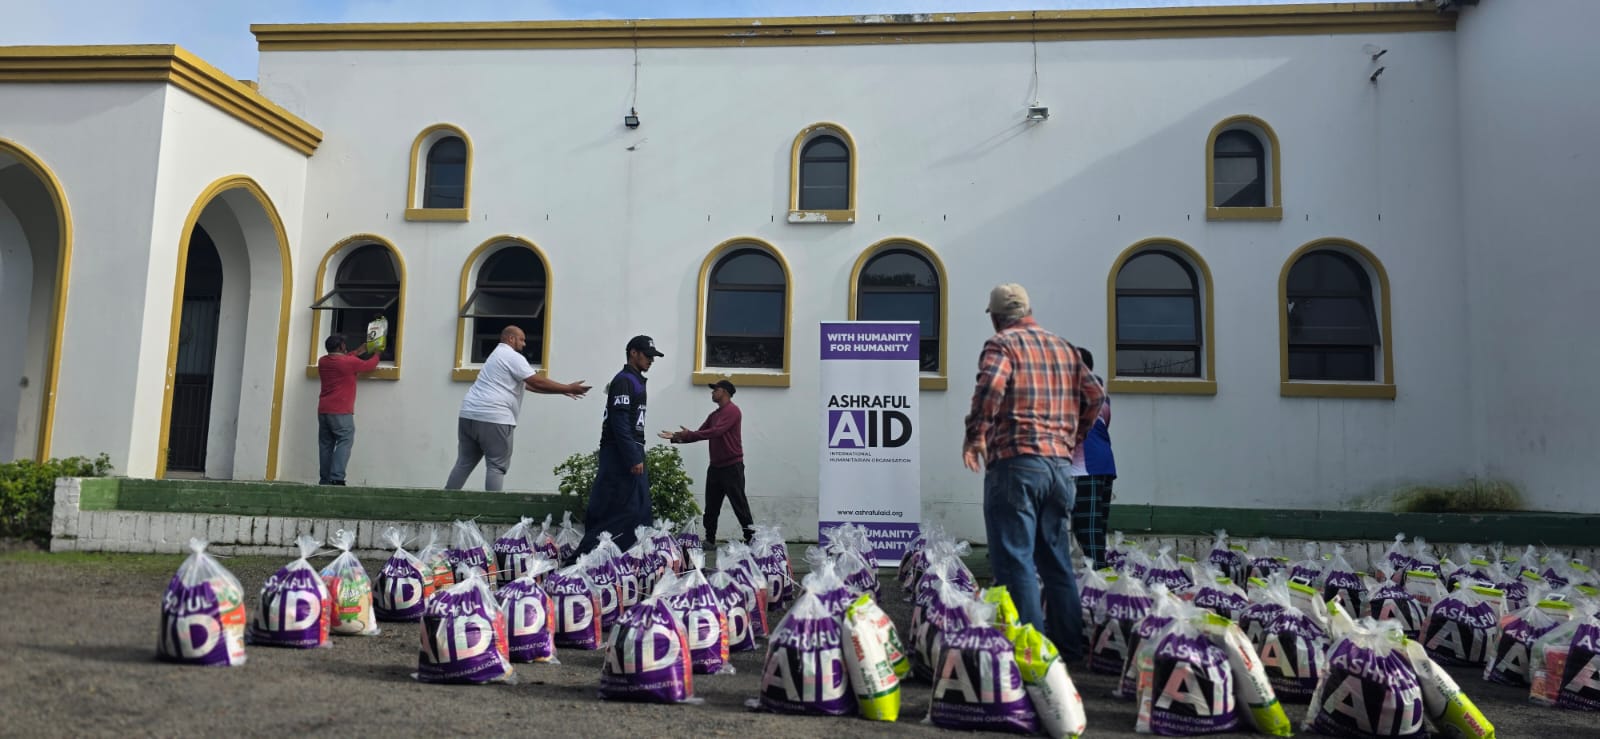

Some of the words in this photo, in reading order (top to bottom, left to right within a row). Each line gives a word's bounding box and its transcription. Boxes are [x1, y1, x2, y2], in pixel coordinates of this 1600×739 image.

[827, 333, 855, 342] WITH
[857, 333, 912, 342] HUMANITY
[830, 344, 851, 352] FOR
[854, 344, 909, 352] HUMANITY
[828, 395, 911, 409] ASHRAFUL
[829, 410, 912, 448] AID
[837, 509, 903, 518] www.ashrafulaid.org
[864, 529, 914, 539] UMANITY
[870, 541, 910, 550] MANITY
[761, 647, 848, 703] AID
[934, 649, 1027, 704] AID
